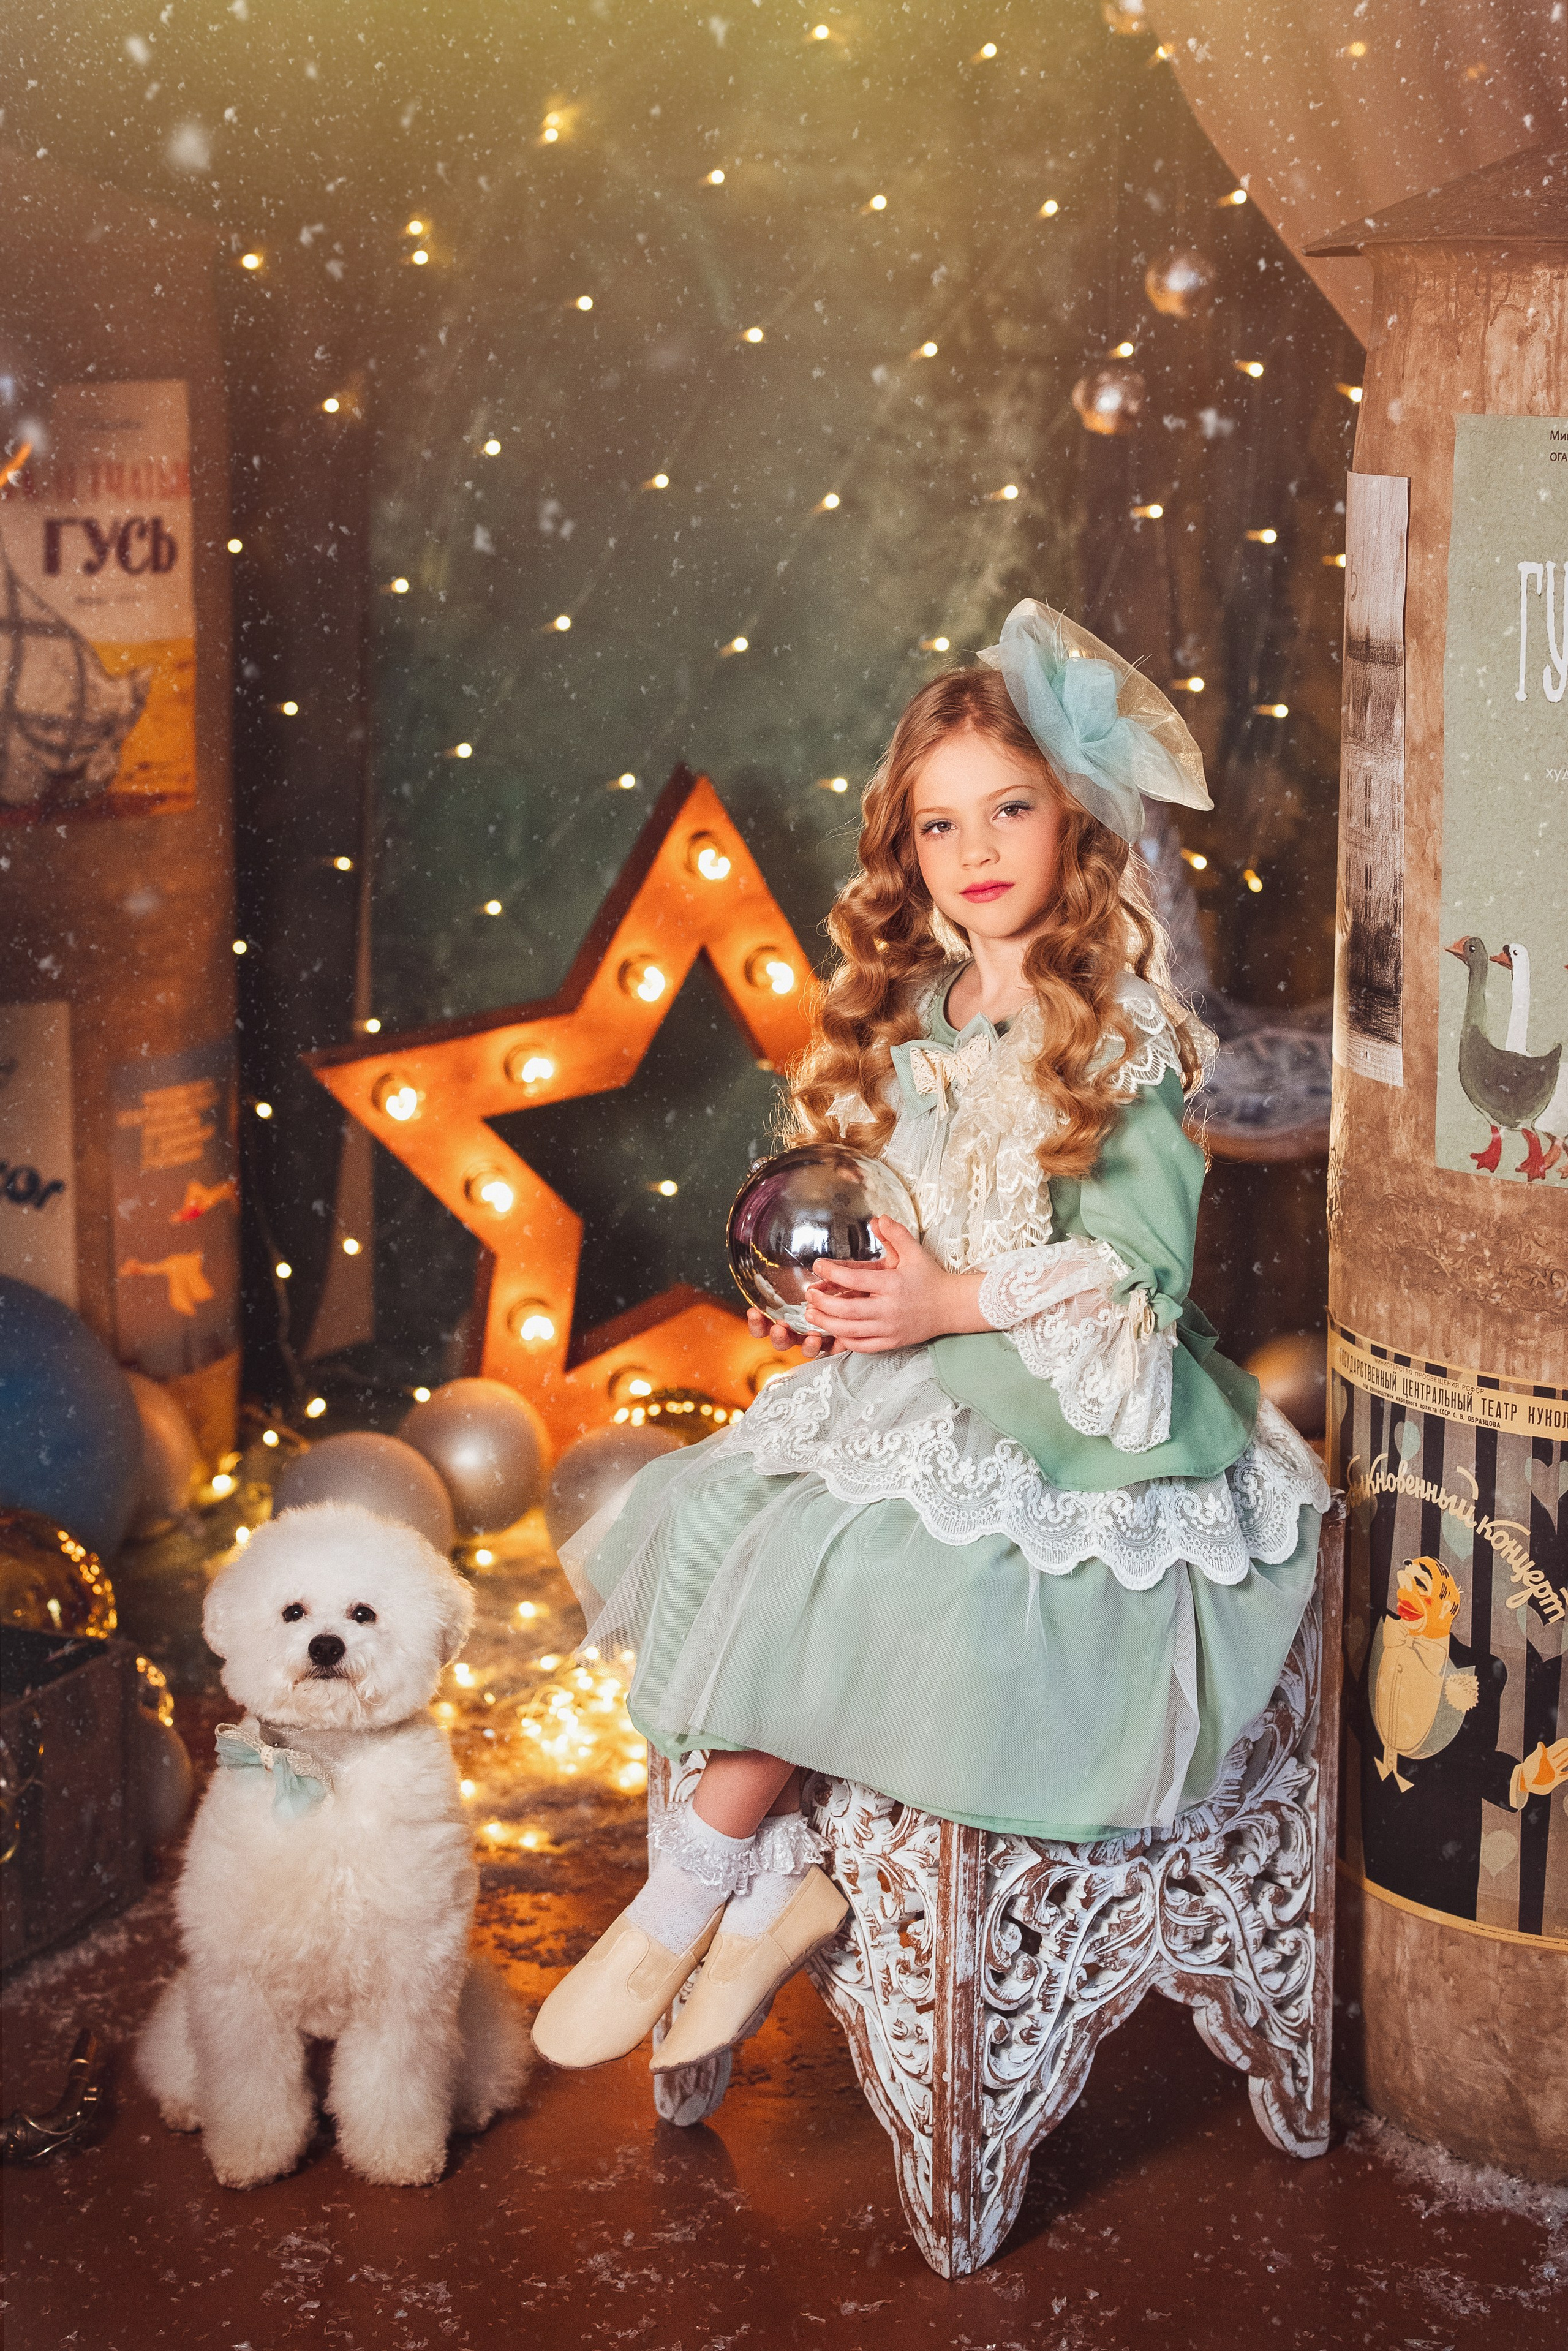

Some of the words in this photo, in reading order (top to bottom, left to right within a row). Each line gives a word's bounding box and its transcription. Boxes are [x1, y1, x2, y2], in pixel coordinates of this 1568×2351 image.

[1550, 430, 1568, 440] Ми
[43, 516, 178, 576] ГУСЬ
[1338, 1347, 1396, 1392] ГОСУДАРСТВЕННЫЙ
[1402, 1377, 1473, 1413] ЦЕНТРАЛЬНЫЙ
[1481, 1397, 1518, 1421] ТЕАТР
[1528, 1406, 1568, 1429] КУКОЛ
[1374, 1357, 1413, 1375] МИНИСТЕРСТВО
[1414, 1371, 1460, 1389] ПРОСВЕЩЕНИЯ
[1461, 1384, 1485, 1394] РСФСР
[1419, 1403, 1438, 1413] артиста
[1468, 1415, 1501, 1428] ОБРАЗЦОВА
